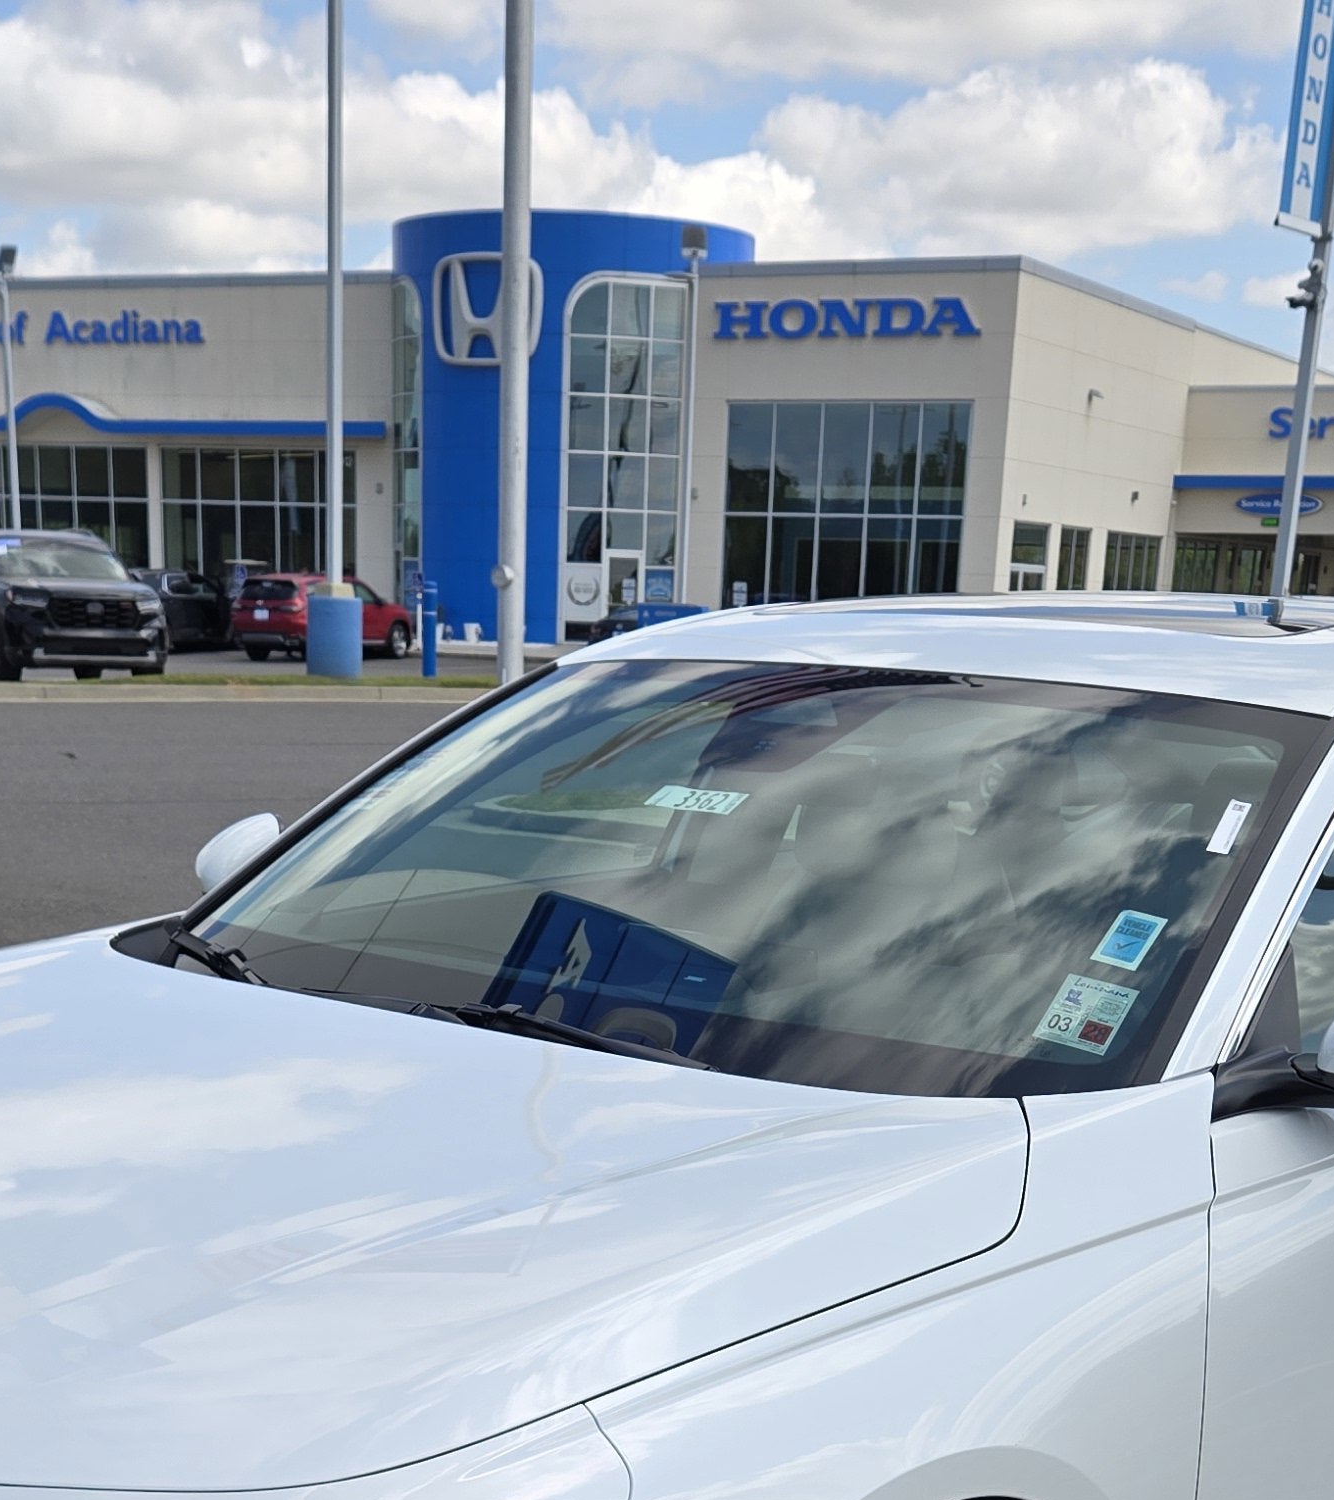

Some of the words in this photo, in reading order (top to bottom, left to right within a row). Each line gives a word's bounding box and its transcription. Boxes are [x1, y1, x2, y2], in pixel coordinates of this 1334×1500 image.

[45, 310, 204, 345] Acadiana
[713, 297, 982, 340] HONDA
[673, 790, 730, 811] 3562
[1047, 1013, 1073, 1032] 03
